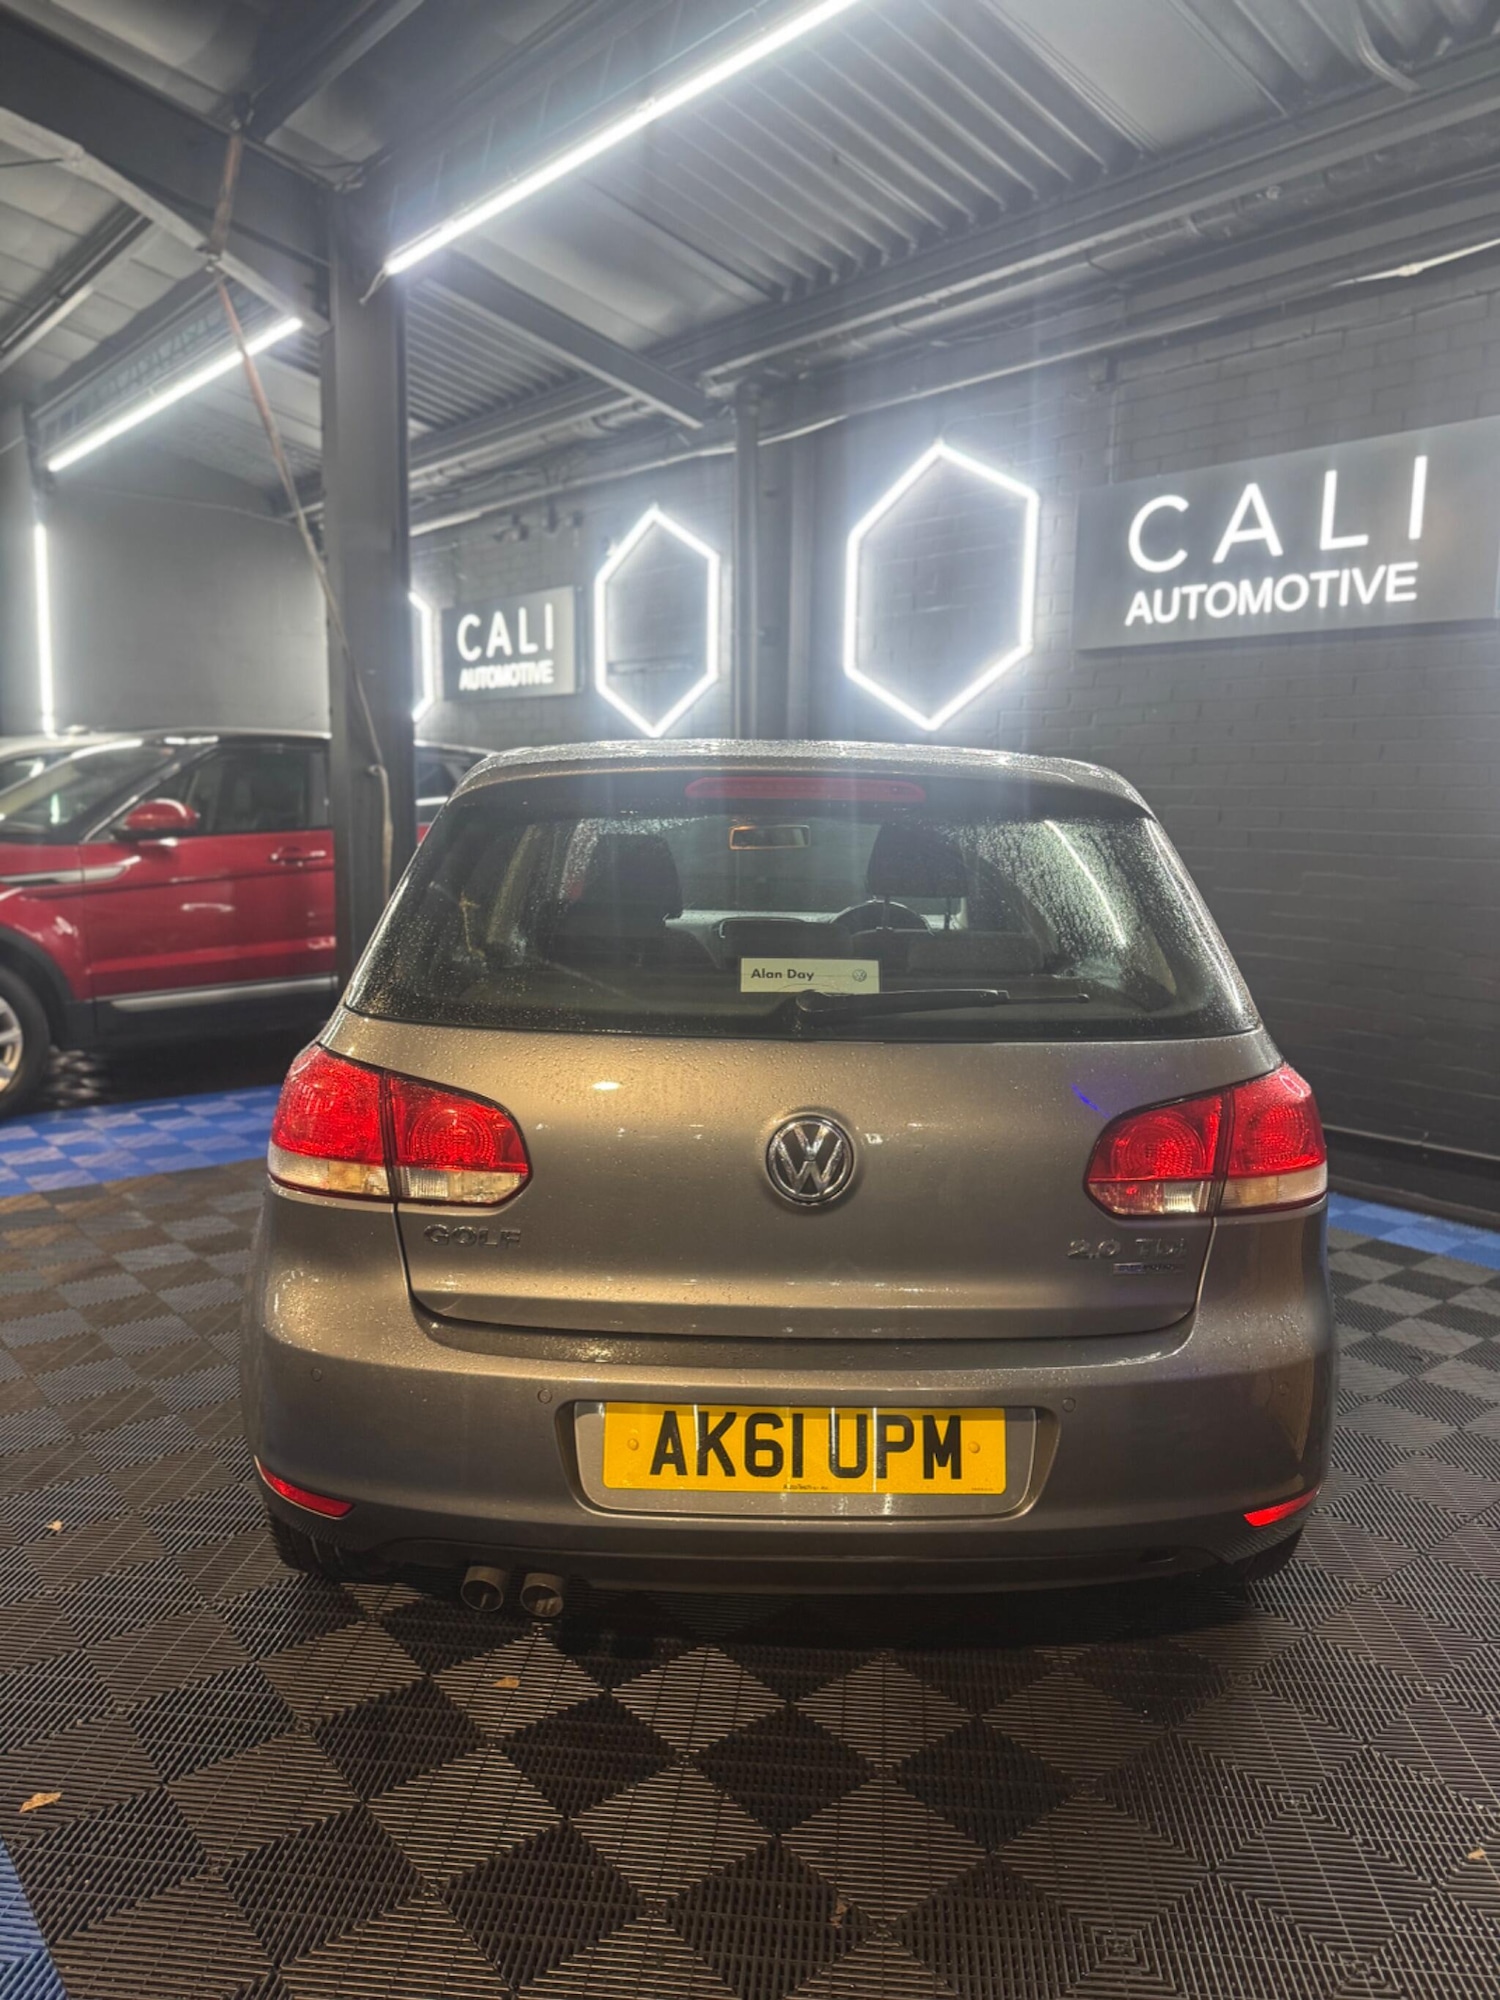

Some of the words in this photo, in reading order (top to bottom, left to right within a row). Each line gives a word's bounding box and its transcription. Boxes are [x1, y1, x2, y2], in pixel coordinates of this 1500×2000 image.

[1128, 455, 1428, 573] CALI
[1125, 561, 1419, 627] AUTOMOTIVE
[457, 602, 554, 662] CALI
[459, 659, 554, 691] AUTOMOTIVE
[751, 968, 782, 979] Alan
[787, 969, 814, 982] Day
[423, 1223, 521, 1249] GOLF
[650, 1410, 804, 1478] AK61
[831, 1413, 962, 1480] UPM
